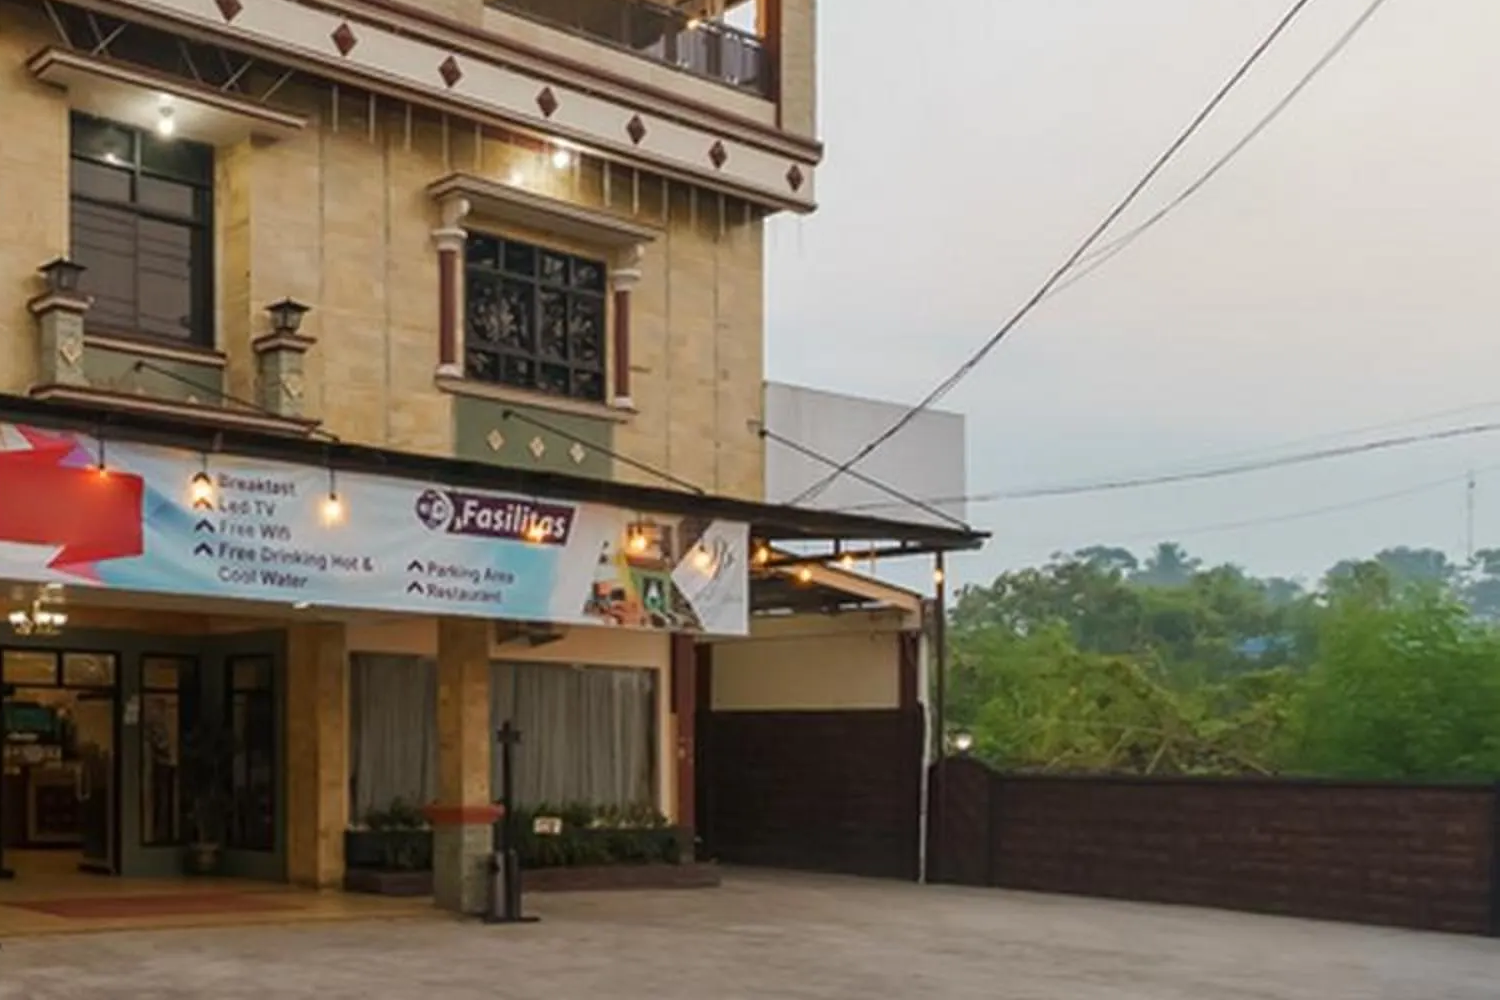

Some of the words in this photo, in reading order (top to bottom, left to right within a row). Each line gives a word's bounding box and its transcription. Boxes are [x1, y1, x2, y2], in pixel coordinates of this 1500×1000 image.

[218, 473, 296, 496] Breakfast
[219, 497, 250, 514] Led
[254, 501, 276, 516] TV
[219, 520, 255, 538] Free
[462, 500, 566, 537] Fasilitas
[219, 542, 256, 561] Free
[261, 547, 328, 571] Drinking
[331, 554, 358, 571] Hot
[218, 566, 257, 584] Cool
[260, 571, 308, 589] Water
[427, 560, 481, 584] Parking
[484, 567, 515, 584] Area
[427, 583, 502, 603] Restaurant
